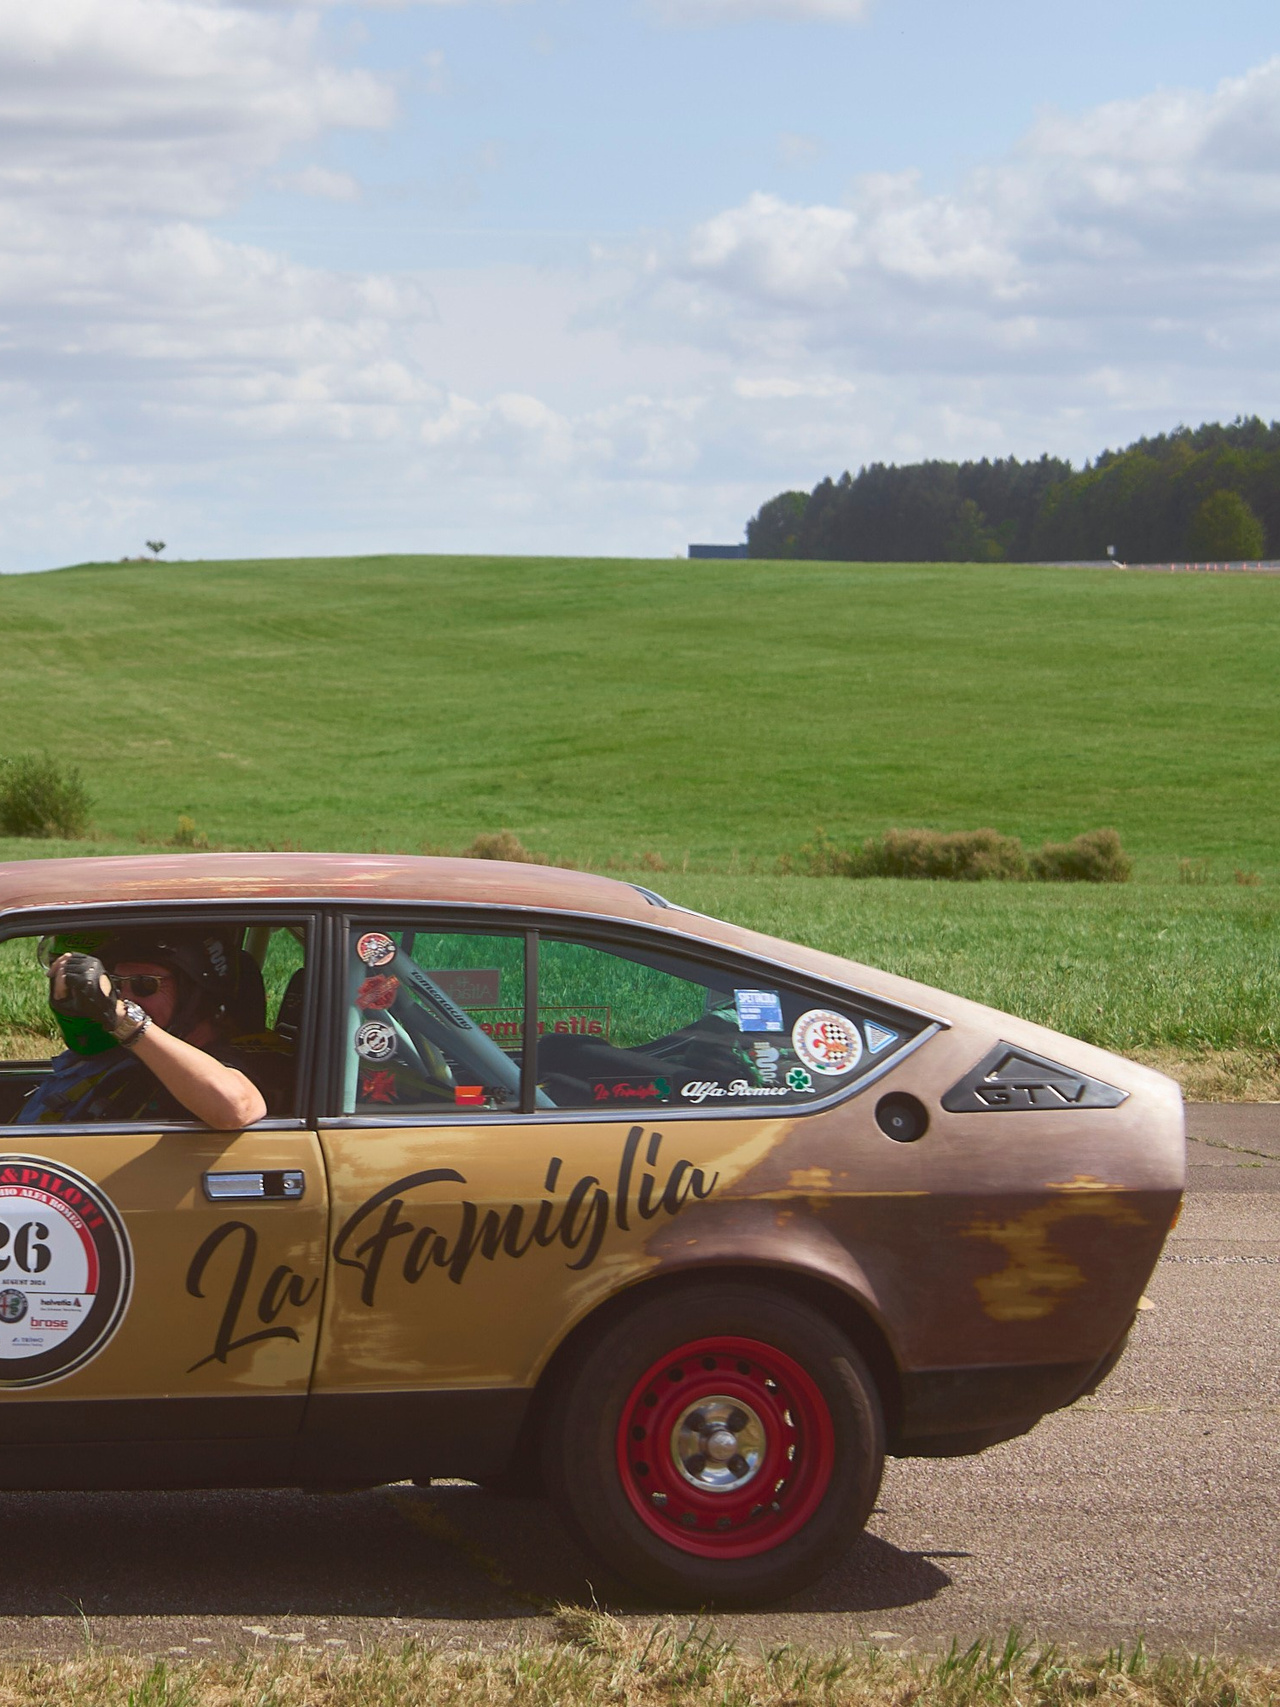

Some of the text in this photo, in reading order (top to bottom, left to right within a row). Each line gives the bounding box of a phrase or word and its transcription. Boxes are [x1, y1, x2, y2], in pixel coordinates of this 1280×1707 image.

[680, 1078, 792, 1104] Alfa Romeo
[973, 1083, 1087, 1107] GTV
[19, 1189, 49, 1204] ALFA
[49, 1200, 83, 1230] ROMEO
[185, 1126, 720, 1373] La Famiglia
[30, 1316, 69, 1328] brose
